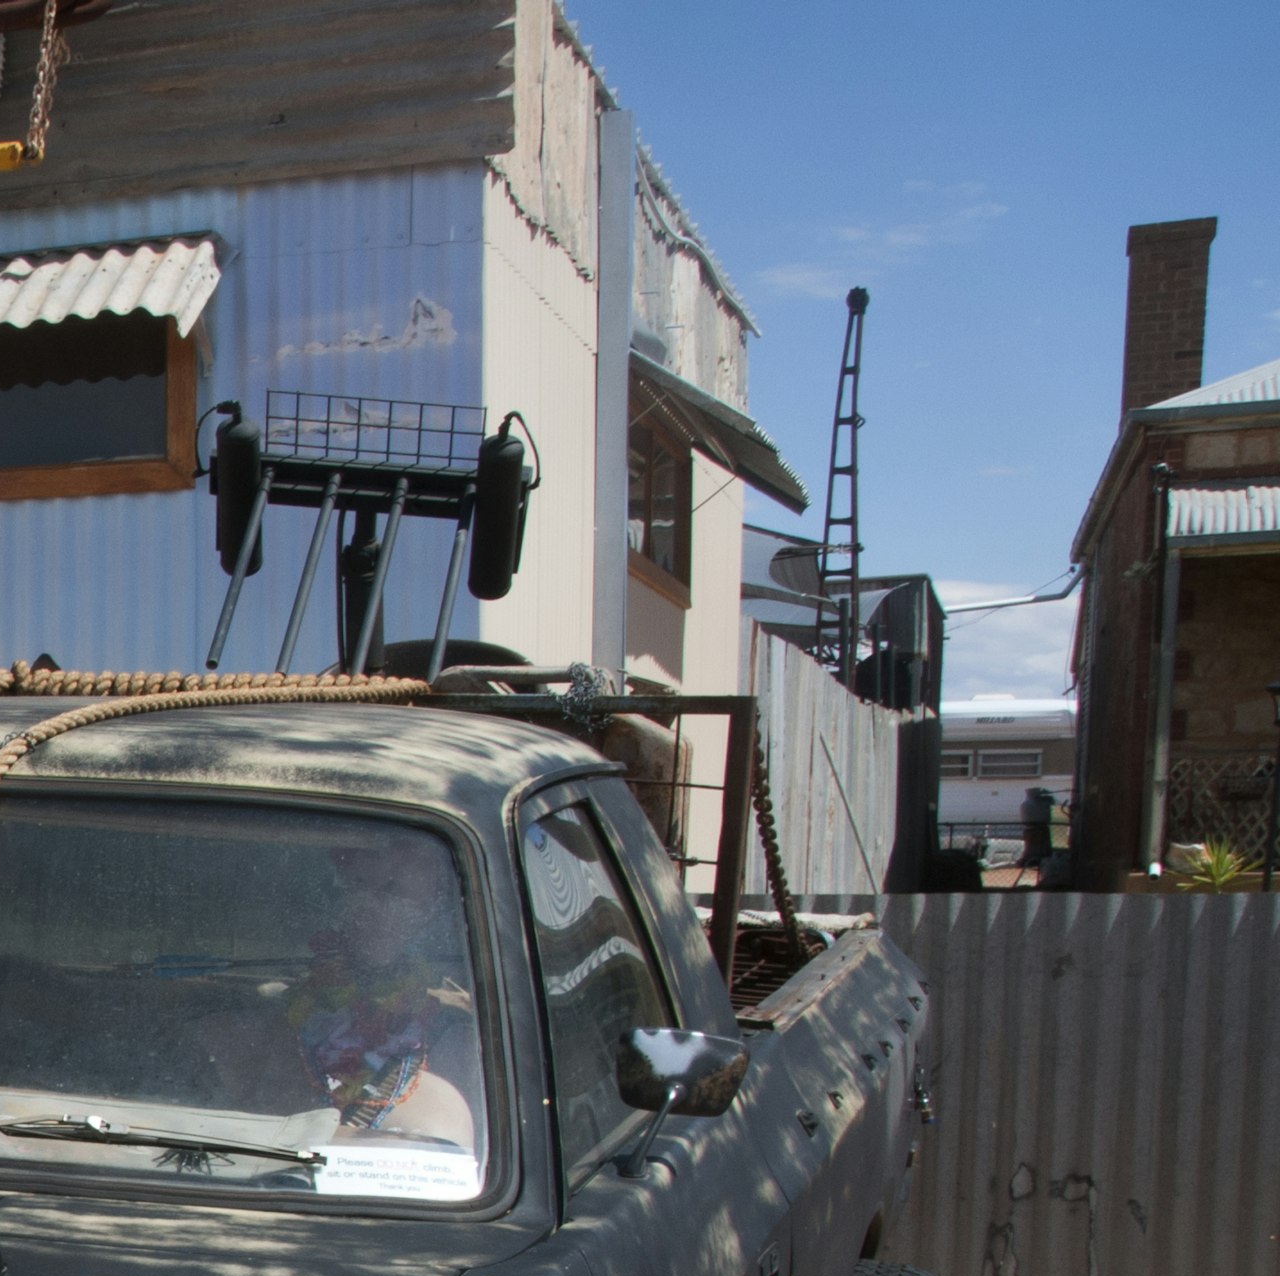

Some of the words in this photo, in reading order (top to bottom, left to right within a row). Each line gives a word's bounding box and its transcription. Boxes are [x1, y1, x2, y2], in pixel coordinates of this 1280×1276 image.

[337, 1157, 374, 1167] Please
[376, 1158, 394, 1169] DO
[327, 1170, 340, 1178] sit
[358, 1171, 390, 1180] stand
[408, 1173, 429, 1183] this
[379, 1182, 405, 1191] Thank
